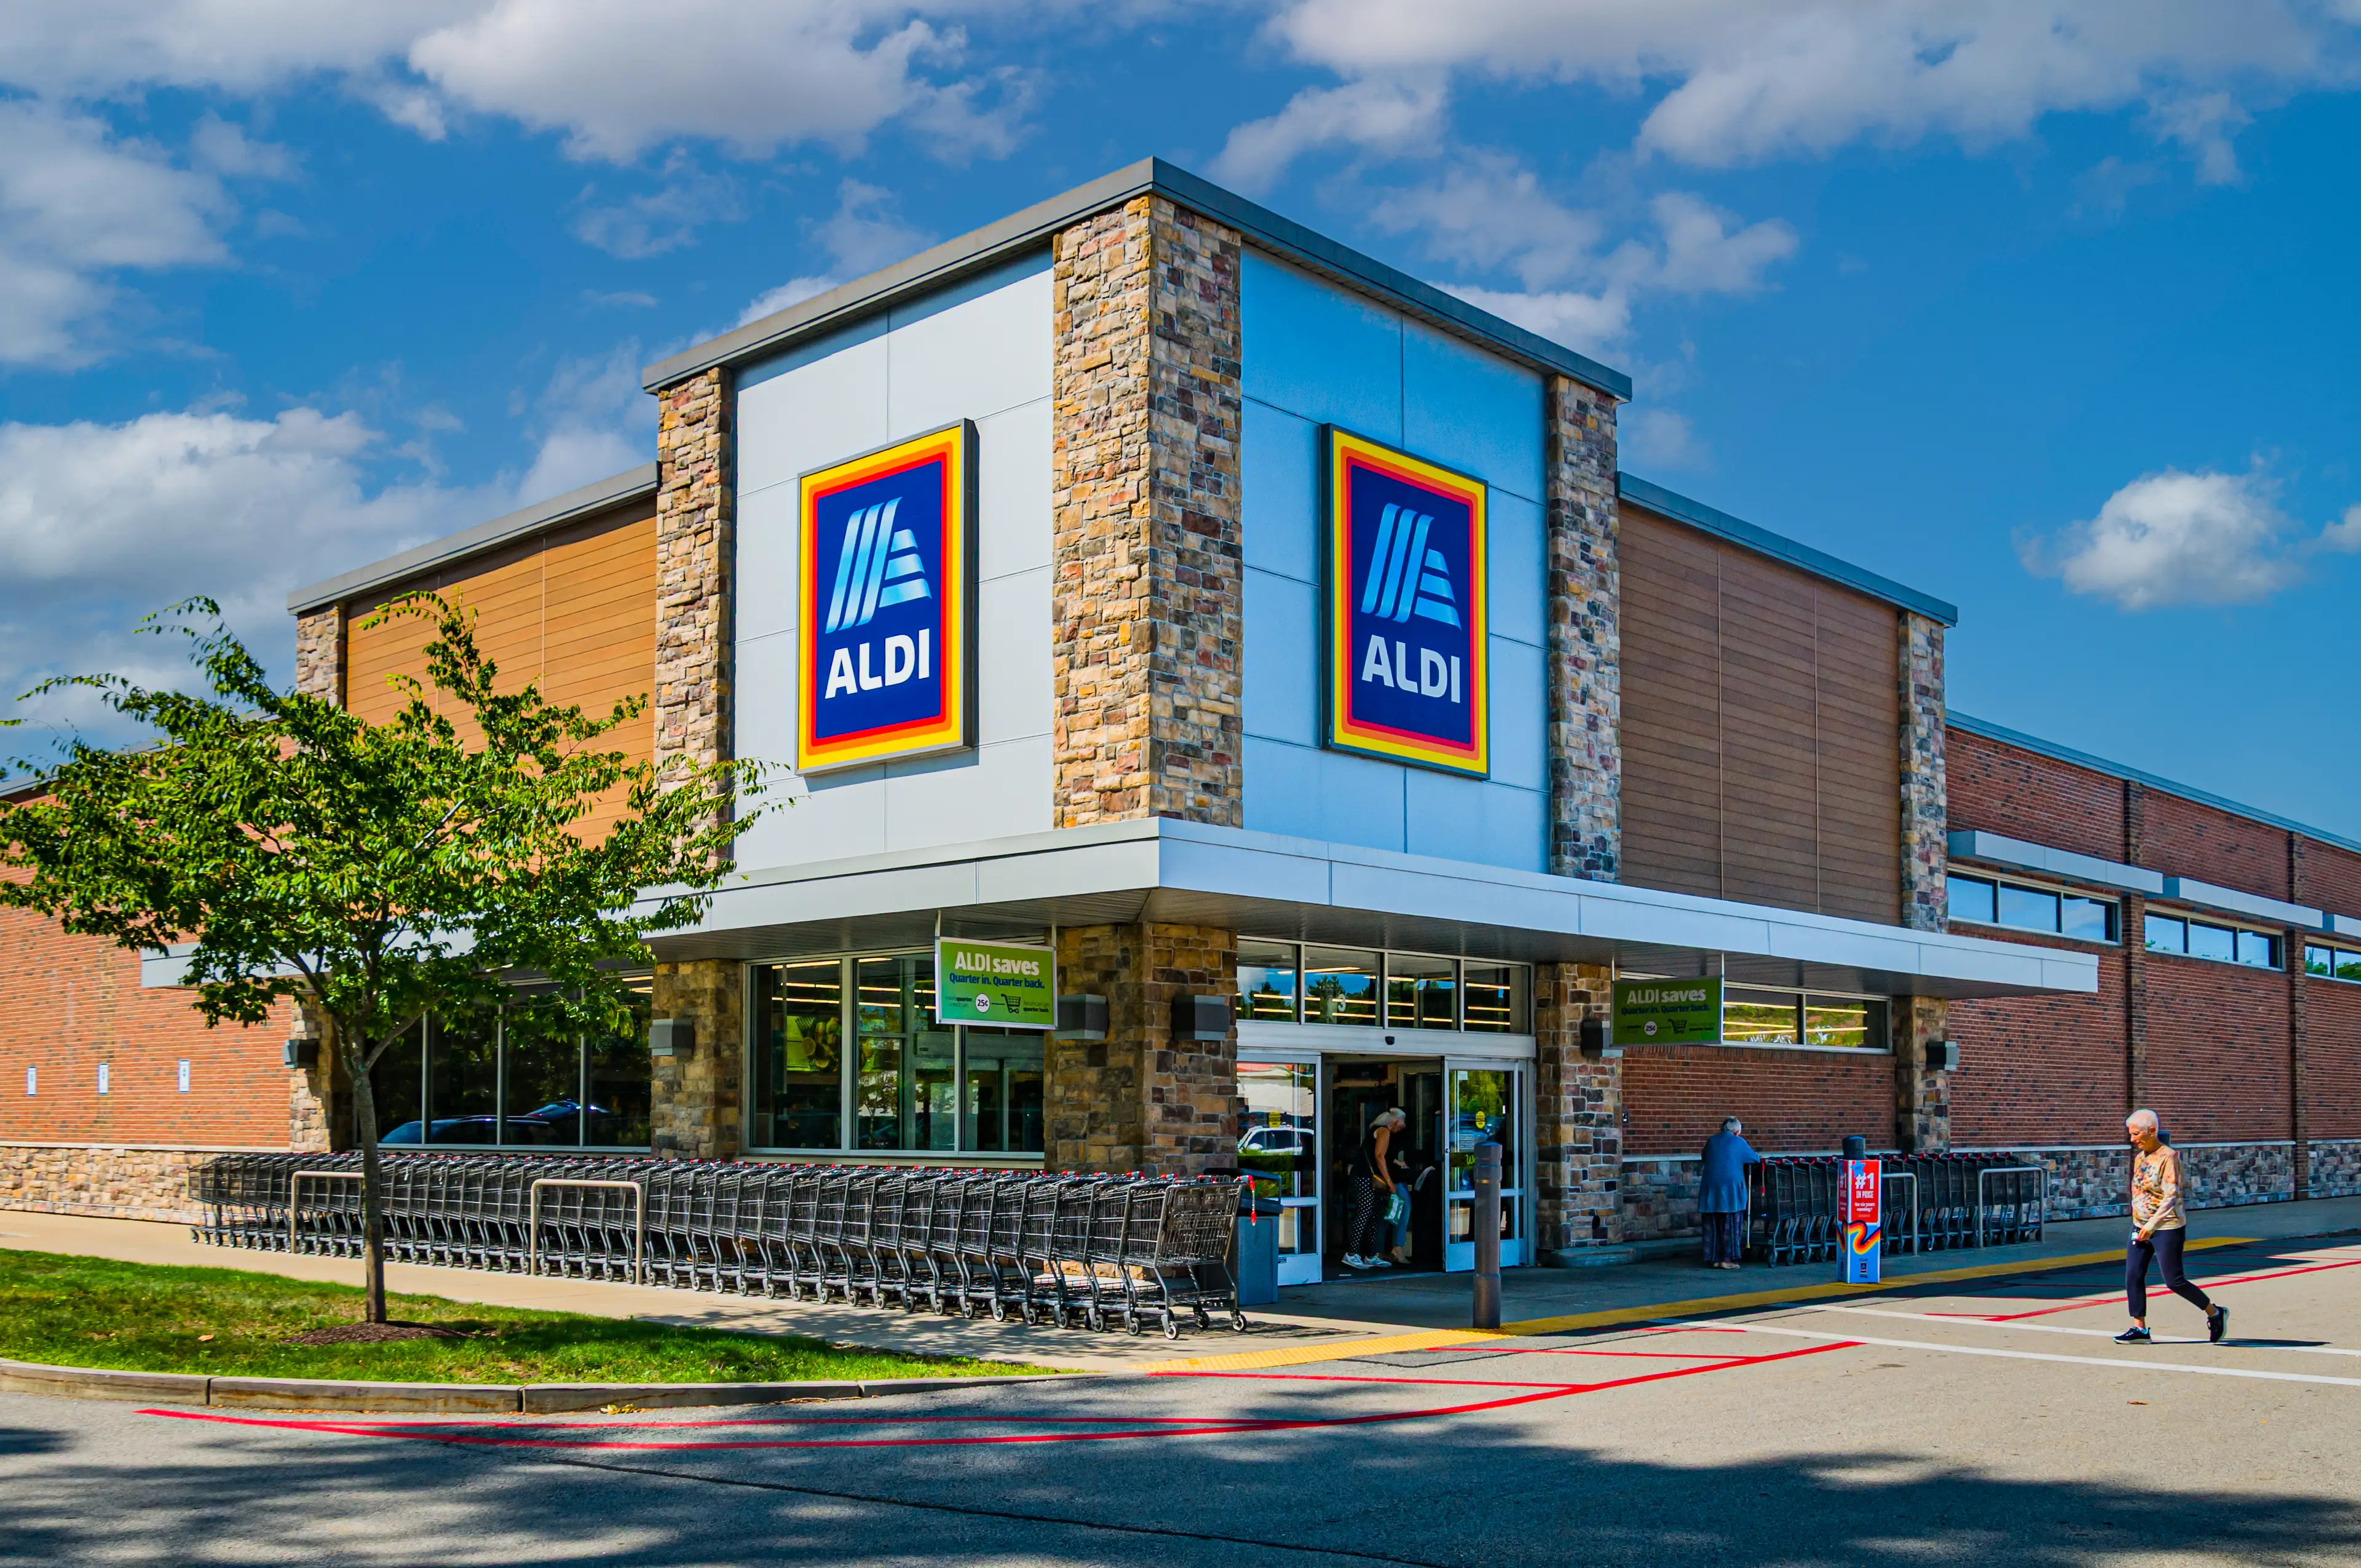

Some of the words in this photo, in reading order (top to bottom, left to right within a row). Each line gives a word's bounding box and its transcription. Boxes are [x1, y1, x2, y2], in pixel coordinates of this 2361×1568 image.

[825, 628, 930, 699] ALDI
[1361, 635, 1460, 703] ALDI
[954, 951, 991, 972] ALDI
[992, 957, 1040, 976] saves
[949, 972, 980, 984] Quarter
[981, 975, 992, 985] in.
[992, 976, 1024, 986] Quarter
[1024, 977, 1045, 989] back.
[1626, 988, 1659, 1004] ALDI
[1661, 989, 1707, 1003] saves
[1621, 1007, 1648, 1015] Quarter
[1661, 1004, 1690, 1013] Quarter
[1690, 1004, 1711, 1012] back.
[1854, 1173, 1874, 1189] #1
